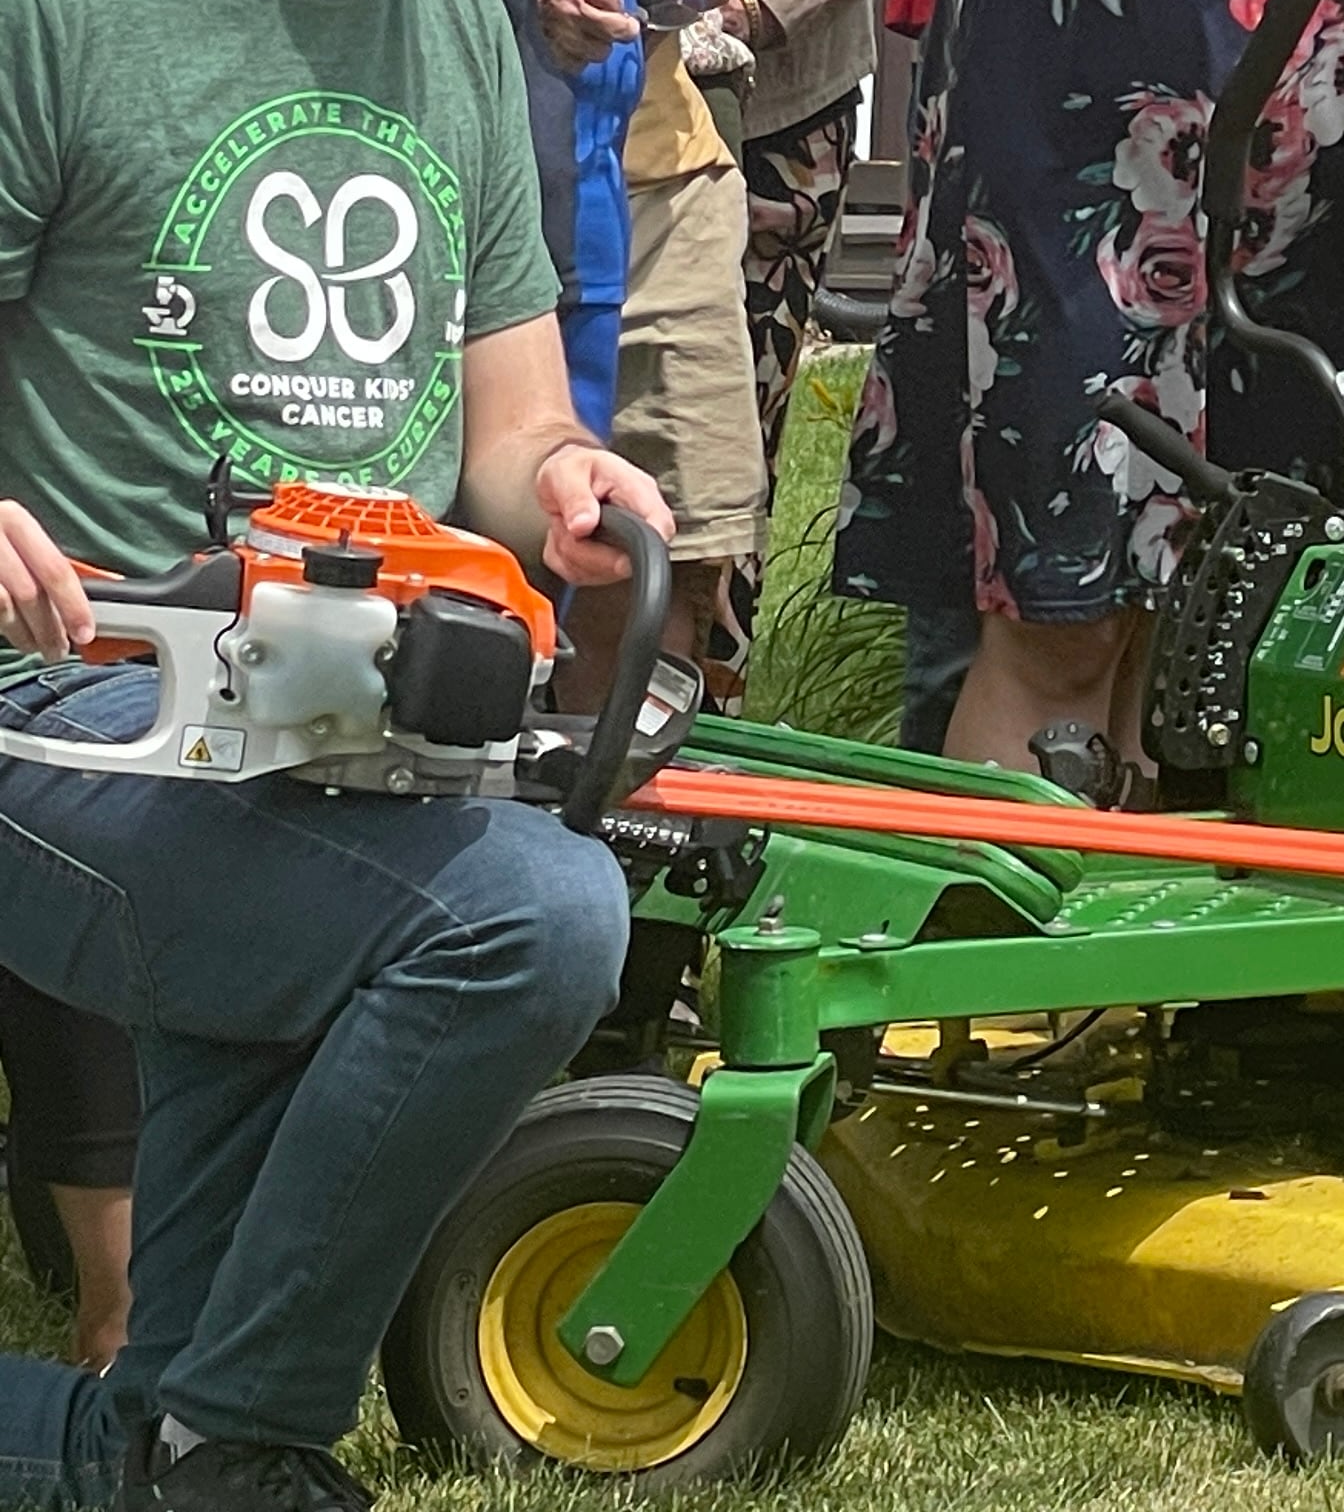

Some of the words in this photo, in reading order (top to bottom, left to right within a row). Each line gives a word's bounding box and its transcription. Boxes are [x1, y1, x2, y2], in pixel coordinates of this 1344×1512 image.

[173, 102, 342, 245] ACCELERATE
[361, 110, 418, 157] THE
[229, 372, 356, 401] CONQUER
[364, 377, 416, 401] KIDS'
[281, 402, 385, 429] CANCER
[386, 379, 452, 472] CURES
